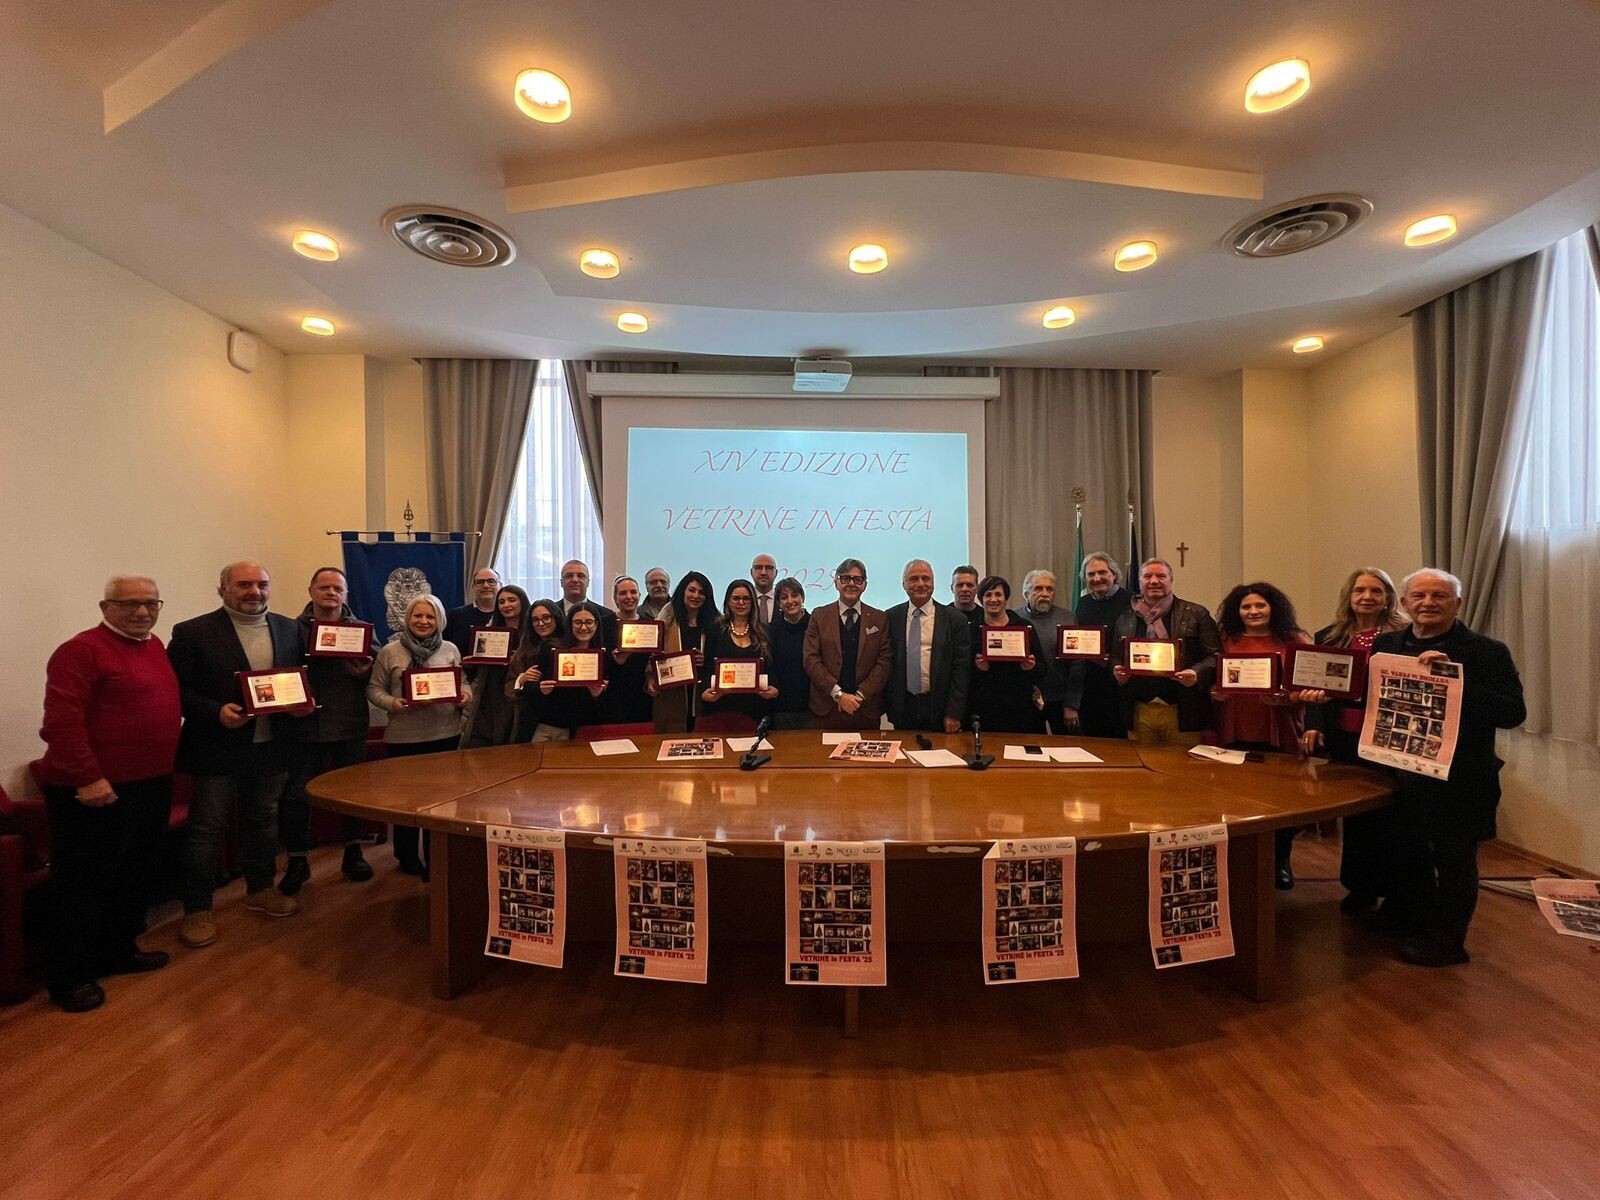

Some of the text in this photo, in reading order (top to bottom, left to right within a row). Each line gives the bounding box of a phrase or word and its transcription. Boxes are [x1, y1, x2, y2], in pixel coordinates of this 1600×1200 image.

[694, 448, 911, 476] XIV EDIZIONE
[663, 505, 933, 537] VETRINE IN FESTA
[527, 935, 544, 943] FESTA
[629, 948, 655, 956] VETRINE
[664, 951, 684, 960] FESTA
[839, 955, 860, 963] FESTA
[996, 952, 1024, 960] VETRINE
[1033, 950, 1053, 958] FESTA
